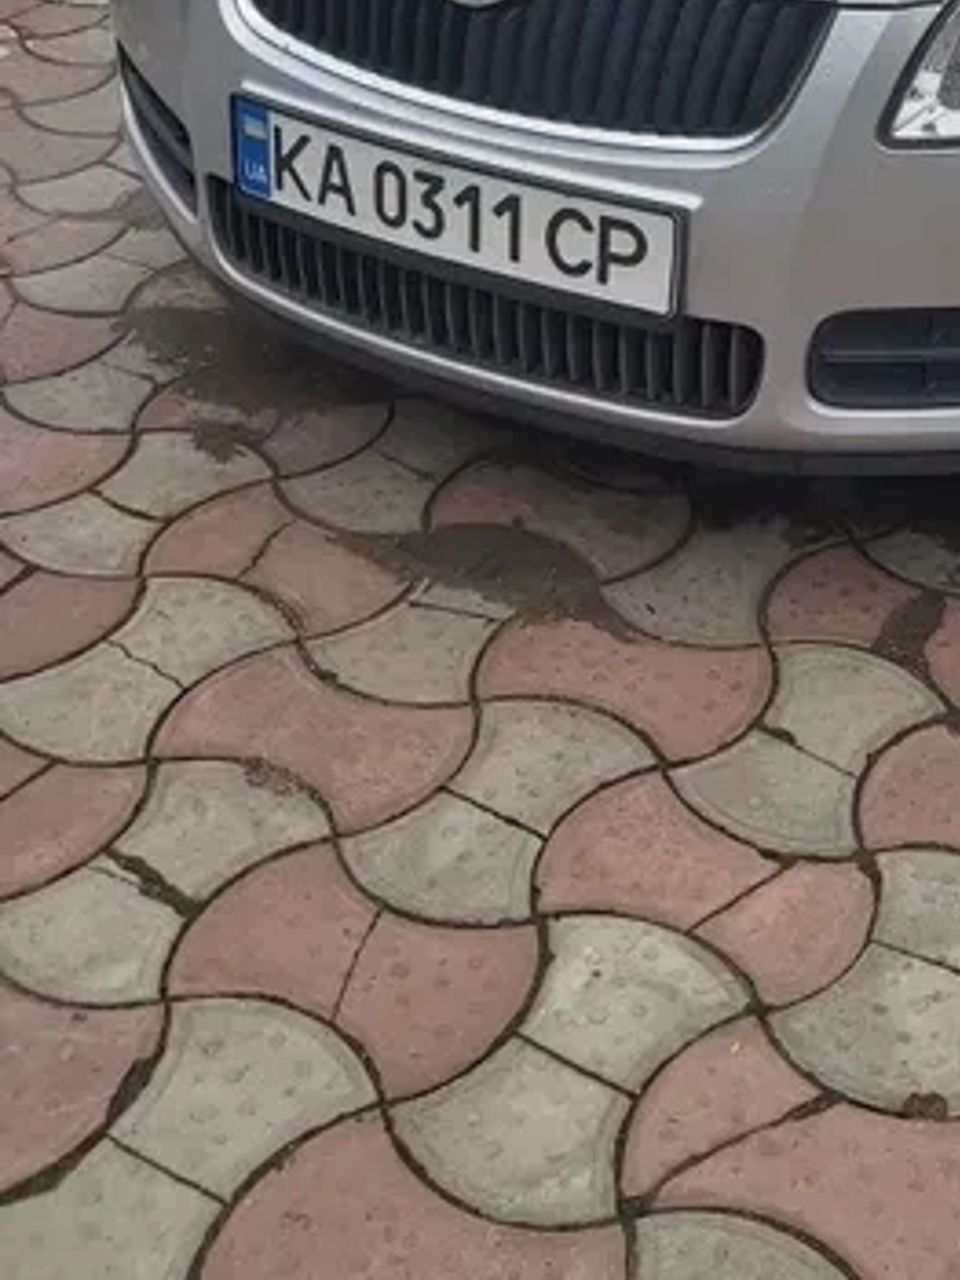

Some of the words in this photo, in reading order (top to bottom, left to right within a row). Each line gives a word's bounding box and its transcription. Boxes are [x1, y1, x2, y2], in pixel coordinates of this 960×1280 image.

[244, 158, 268, 183] UA
[272, 124, 356, 217] KA
[372, 160, 522, 265] 0311
[544, 206, 649, 286] CP
